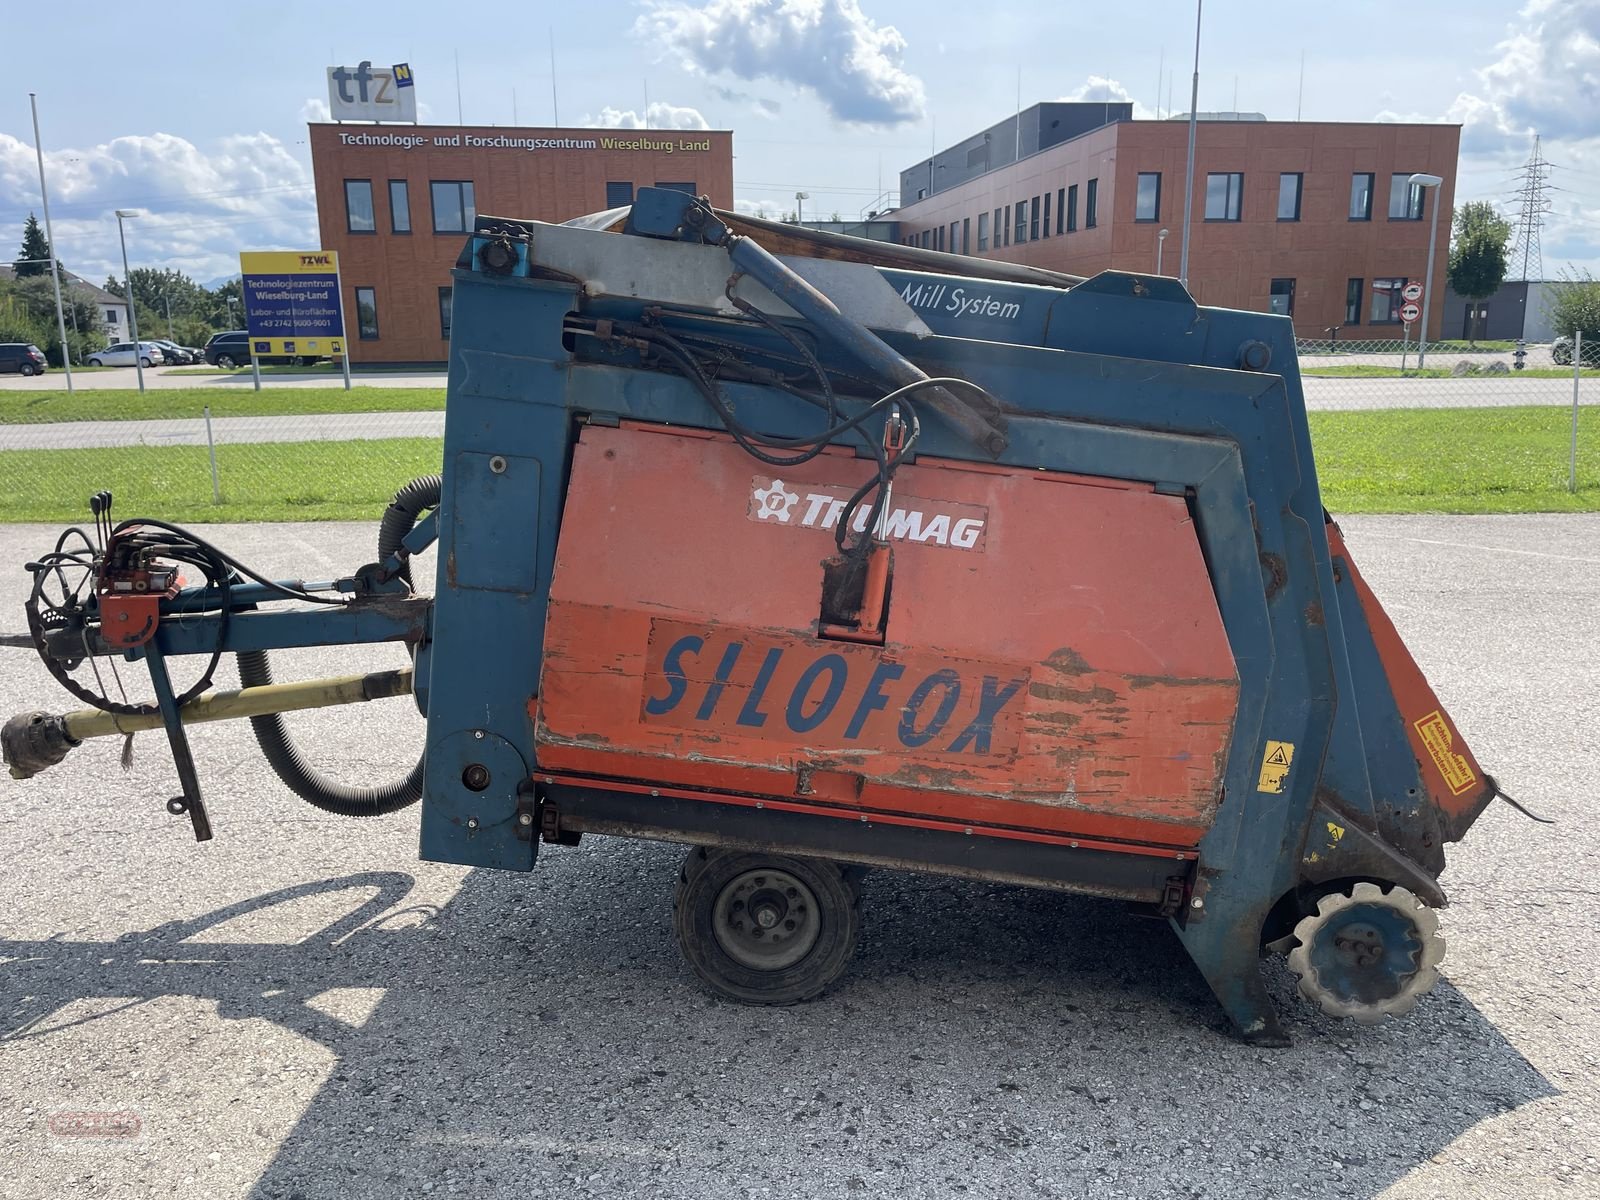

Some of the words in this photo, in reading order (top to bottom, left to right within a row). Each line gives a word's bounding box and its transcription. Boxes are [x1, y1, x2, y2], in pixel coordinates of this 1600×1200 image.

[333, 61, 393, 103] tfz
[339, 133, 429, 149] Technologie-
[434, 135, 460, 146] und
[465, 135, 596, 151] Forschungszentrum
[600, 138, 710, 153] Wieselburg-Land
[248, 280, 334, 290] Technologiezentrum
[256, 291, 328, 301] Wieselburg-Land
[900, 282, 946, 309] Mill
[945, 288, 1020, 318] System
[251, 308, 275, 317] Labor-
[276, 308, 291, 316] und
[259, 319, 273, 328] +43
[645, 635, 1026, 755] SILOFOX
[1427, 741, 1451, 776] verboten!
